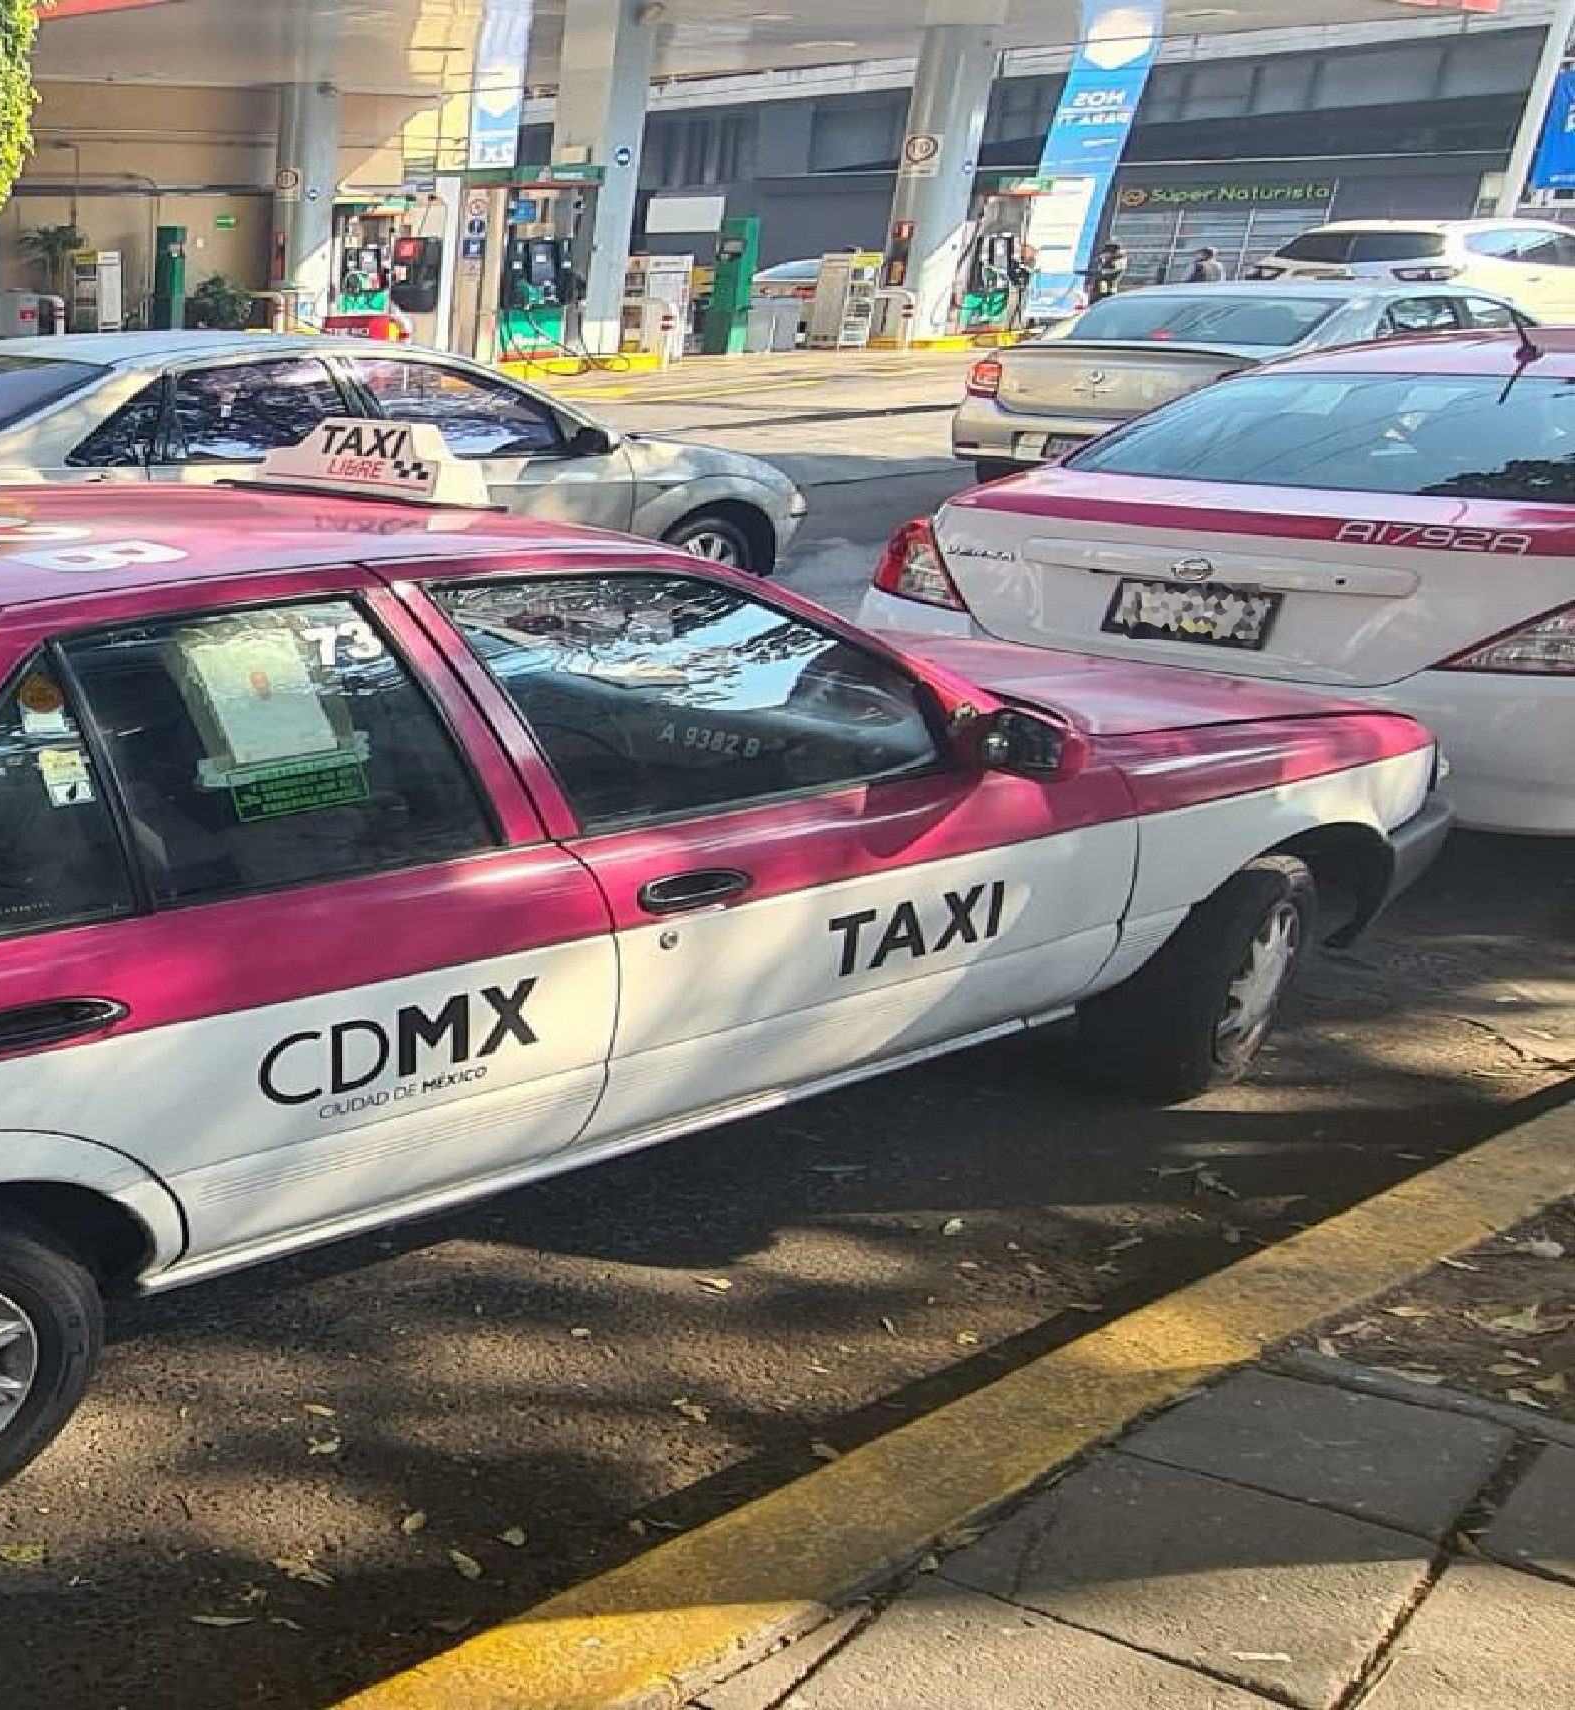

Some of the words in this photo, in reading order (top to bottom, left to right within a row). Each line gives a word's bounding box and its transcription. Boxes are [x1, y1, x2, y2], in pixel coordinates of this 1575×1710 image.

[321, 424, 408, 458] TAXI
[327, 458, 386, 479] LIBRE
[300, 621, 383, 666] 73
[655, 723, 675, 744] A
[828, 880, 1004, 976] TAXI
[258, 976, 539, 1106] CDMX
[319, 1090, 389, 1119] CIUDAD
[393, 1082, 419, 1101] DE
[421, 1065, 488, 1094] MÉXICO
